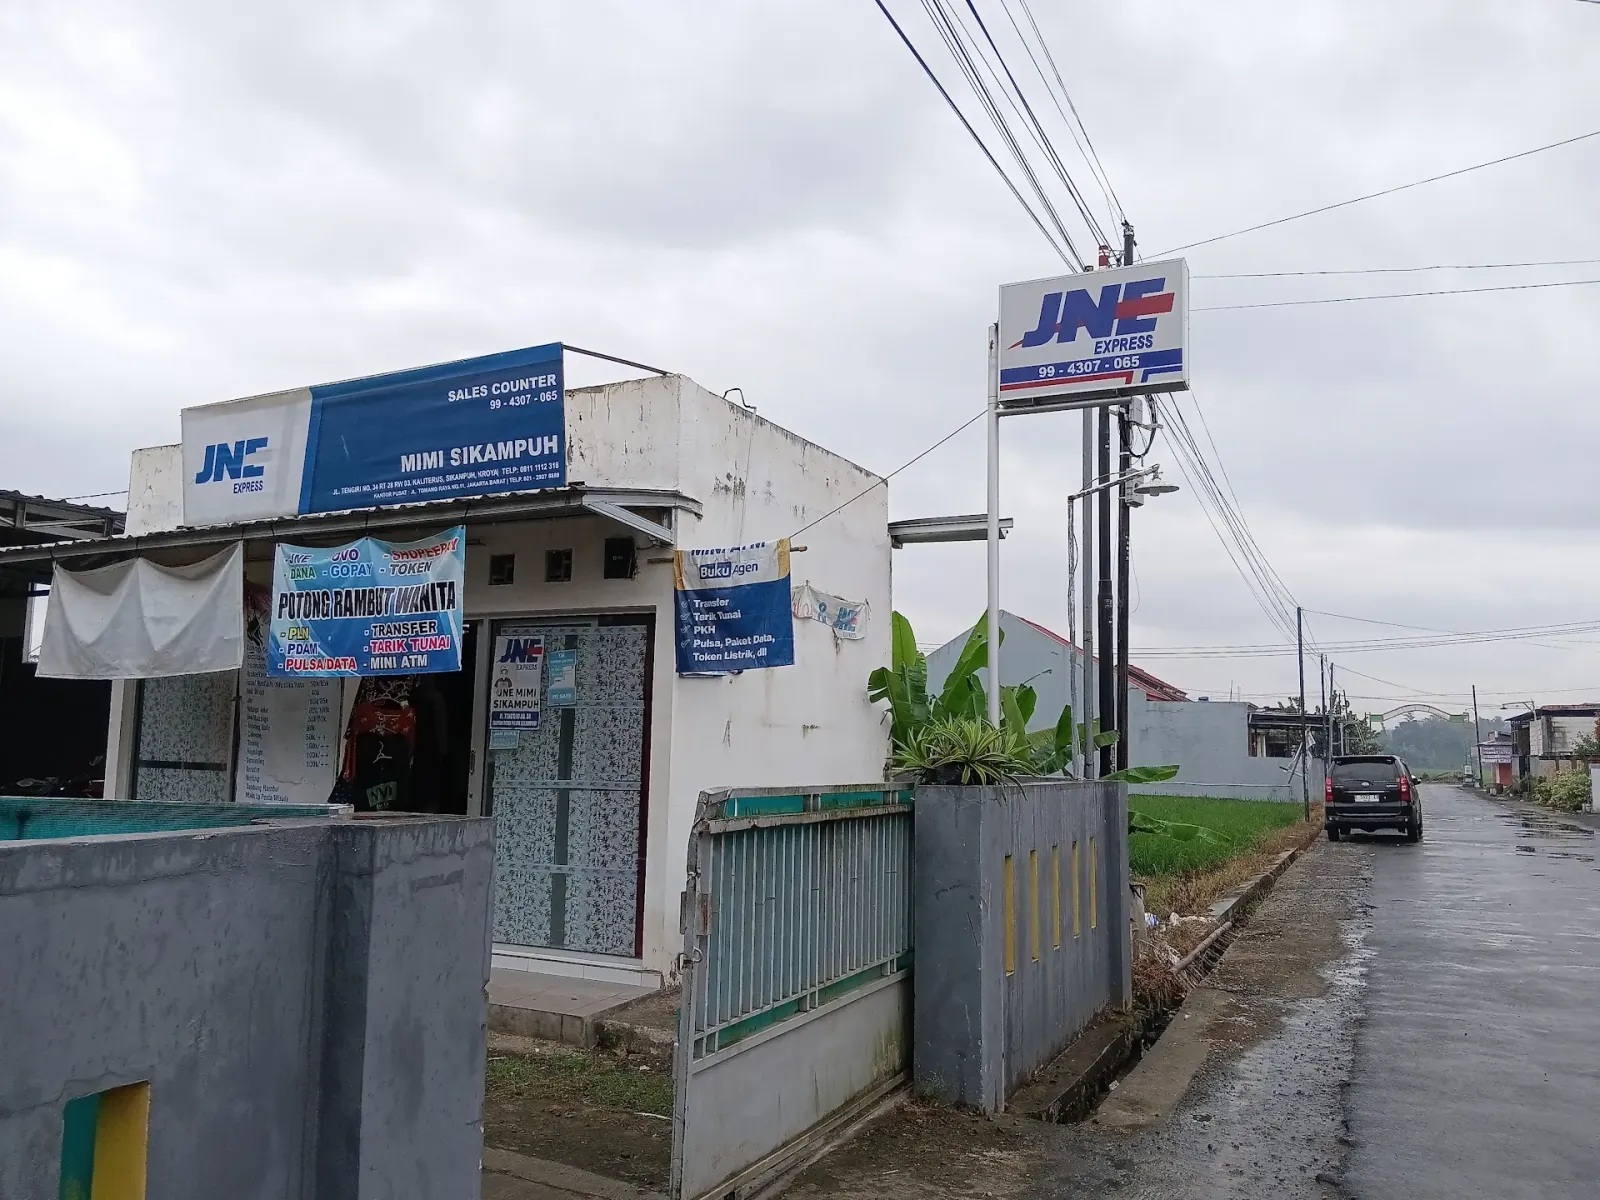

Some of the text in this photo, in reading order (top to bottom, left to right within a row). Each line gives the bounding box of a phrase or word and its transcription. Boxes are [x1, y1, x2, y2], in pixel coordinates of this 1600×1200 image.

[1021, 278, 1175, 348] JNE
[1094, 334, 1153, 354] EXPRESS
[1038, 366, 1056, 378] 99
[1068, 360, 1100, 374] 4307
[1114, 356, 1140, 370] 065
[448, 374, 557, 402] SALES COUNTER
[490, 398, 502, 410] 99
[510, 394, 532, 407] 4307
[540, 391, 558, 403] 065
[196, 436, 268, 484] JNE
[400, 435, 558, 473] MIMI SIKAMPUH
[520, 464, 533, 472] 0811
[232, 480, 264, 494] EXPRESS
[290, 561, 432, 580] DANA GOPAY TOKEN
[700, 562, 758, 578] Buku Agen
[278, 580, 456, 620] POTONG RAMBUT WANITA
[694, 598, 730, 608] Transfer
[693, 610, 741, 622] Tarik Tunai
[288, 621, 438, 640] PLN TRANSFER
[694, 625, 716, 634] PKH
[287, 636, 450, 655] PDAM TARIK TUNAI
[500, 639, 543, 663] JNE
[693, 634, 775, 650] Pulsa, Paket Data,
[370, 656, 397, 670] MINI
[400, 654, 428, 668] ATM
[693, 648, 767, 662] Token Listrik, dll
[498, 689, 513, 697] JNE
[494, 700, 539, 708] SIKAMPUH
